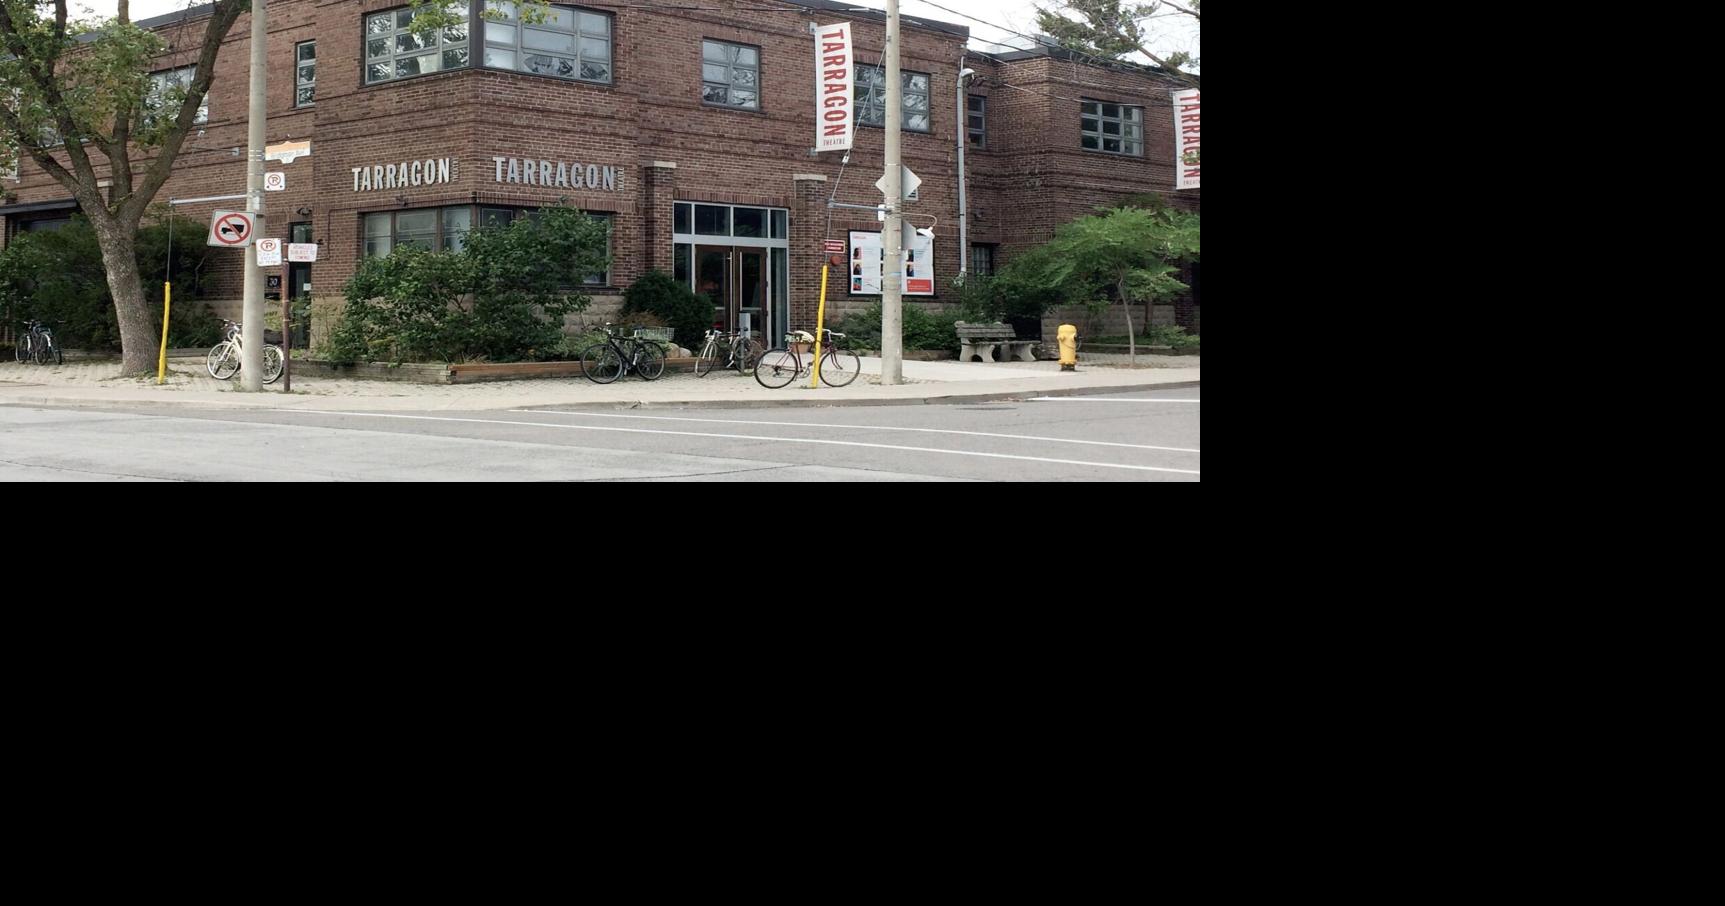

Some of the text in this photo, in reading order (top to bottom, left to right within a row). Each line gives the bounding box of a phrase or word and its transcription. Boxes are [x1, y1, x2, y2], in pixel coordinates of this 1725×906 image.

[822, 29, 847, 136] TARRAGON
[823, 138, 845, 147] THEATRE
[352, 158, 450, 192] TARRAGON
[492, 156, 615, 191] TARRAGON
